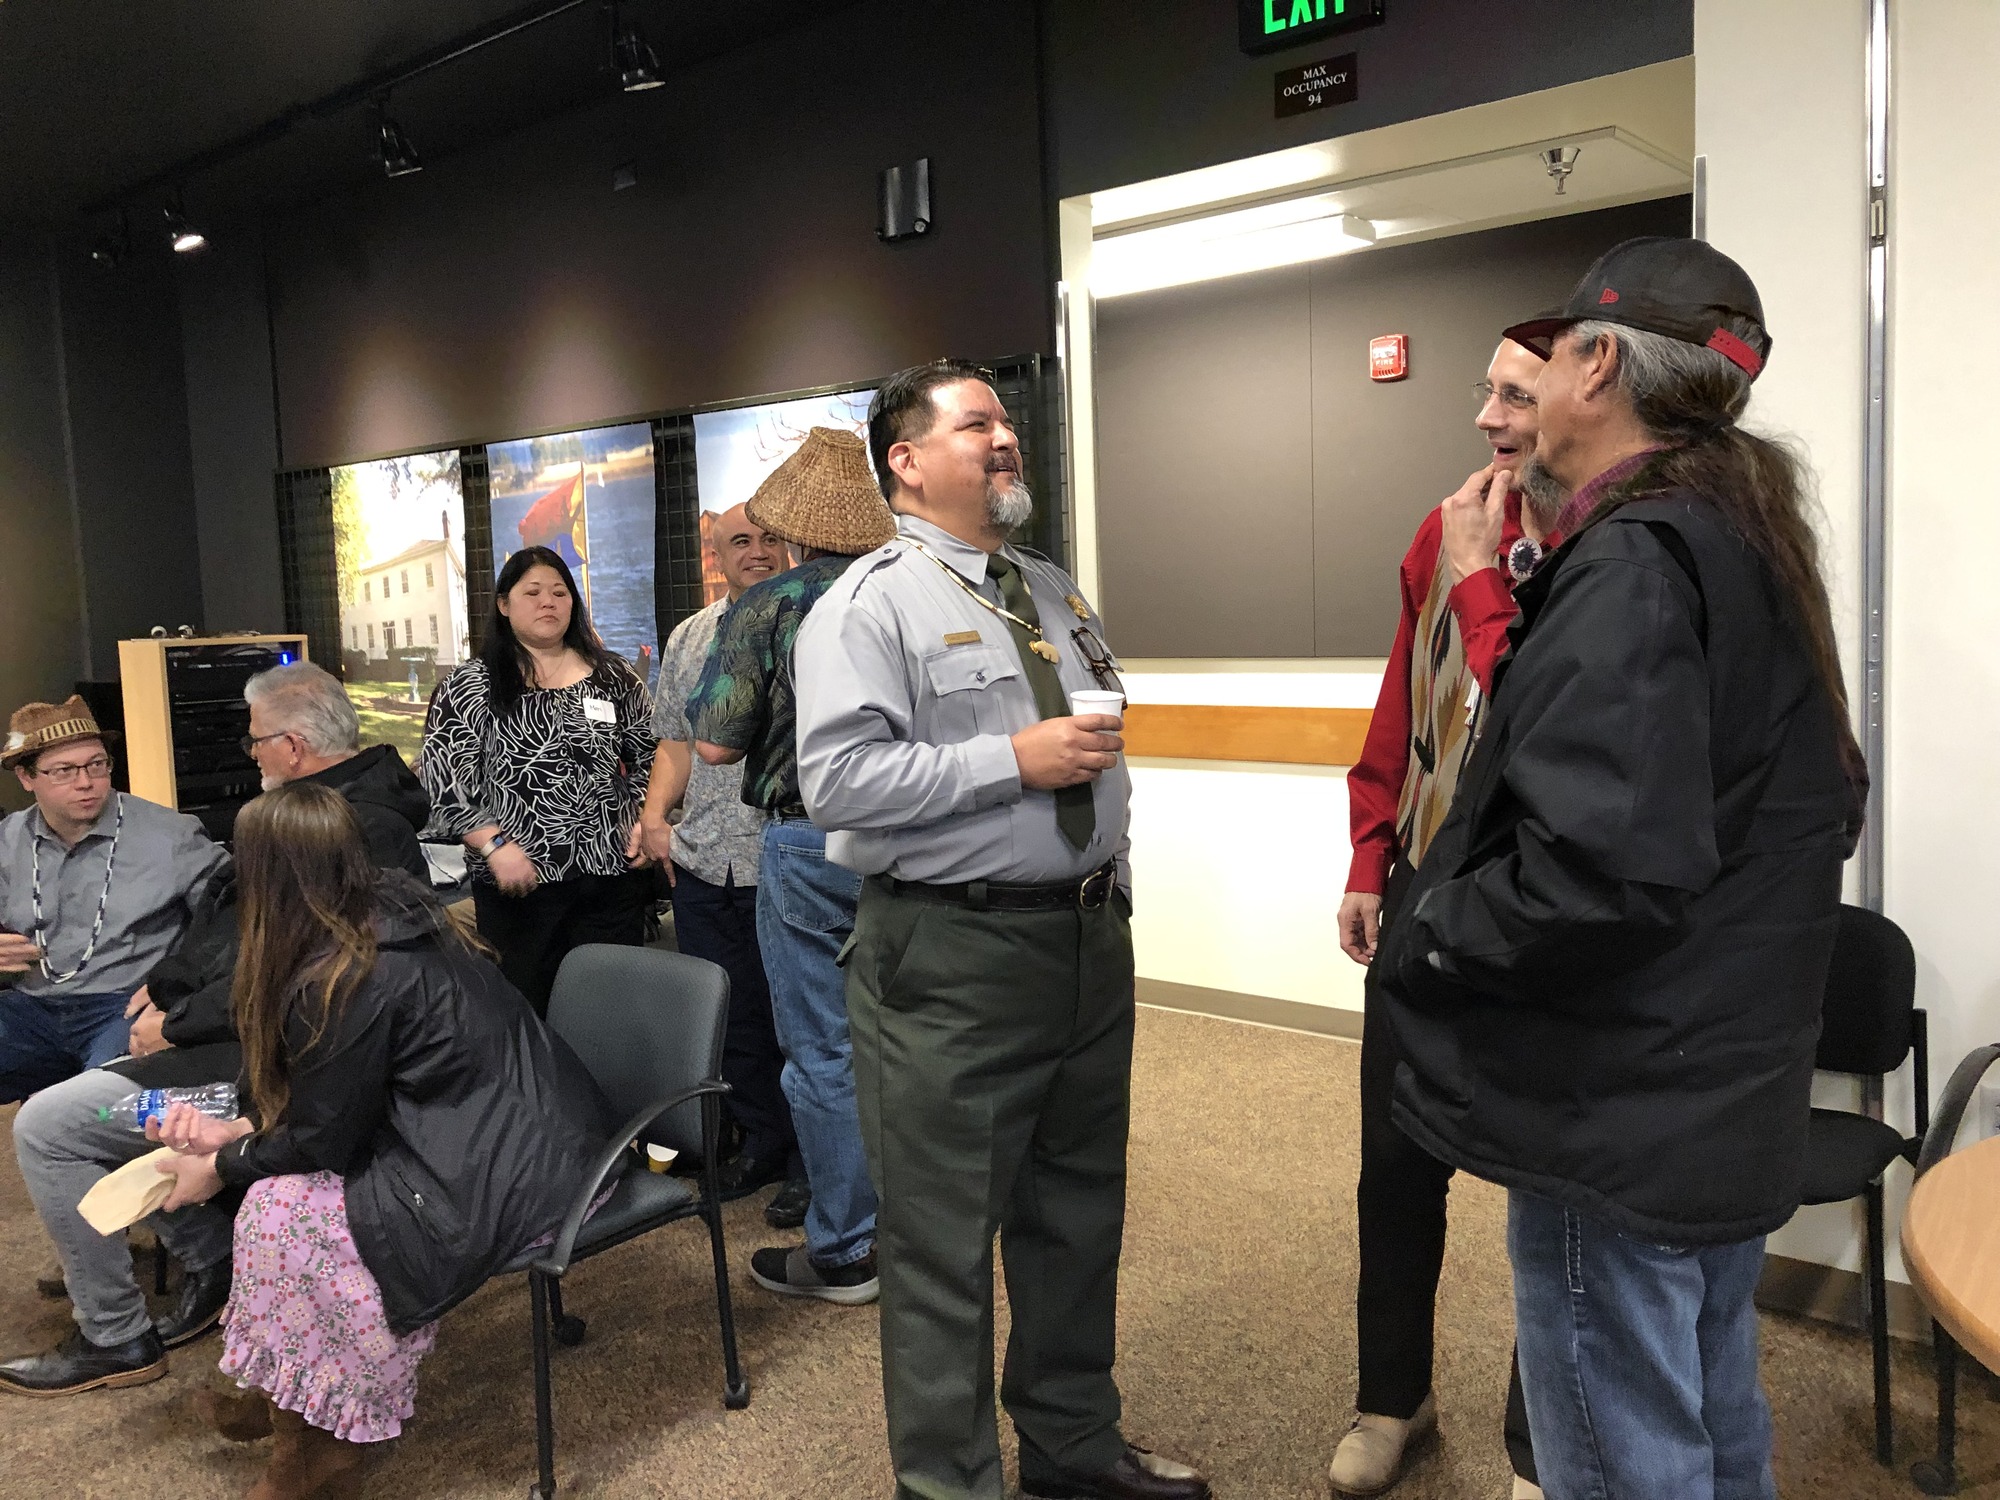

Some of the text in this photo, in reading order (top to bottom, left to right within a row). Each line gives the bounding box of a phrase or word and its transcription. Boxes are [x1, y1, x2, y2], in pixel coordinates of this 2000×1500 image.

[1264, 0, 1344, 34] EX
[1303, 65, 1327, 80] MAX
[1283, 72, 1348, 97] OCCUPANCY
[1308, 92, 1322, 106] 94
[140, 1090, 152, 1110] DASAN
